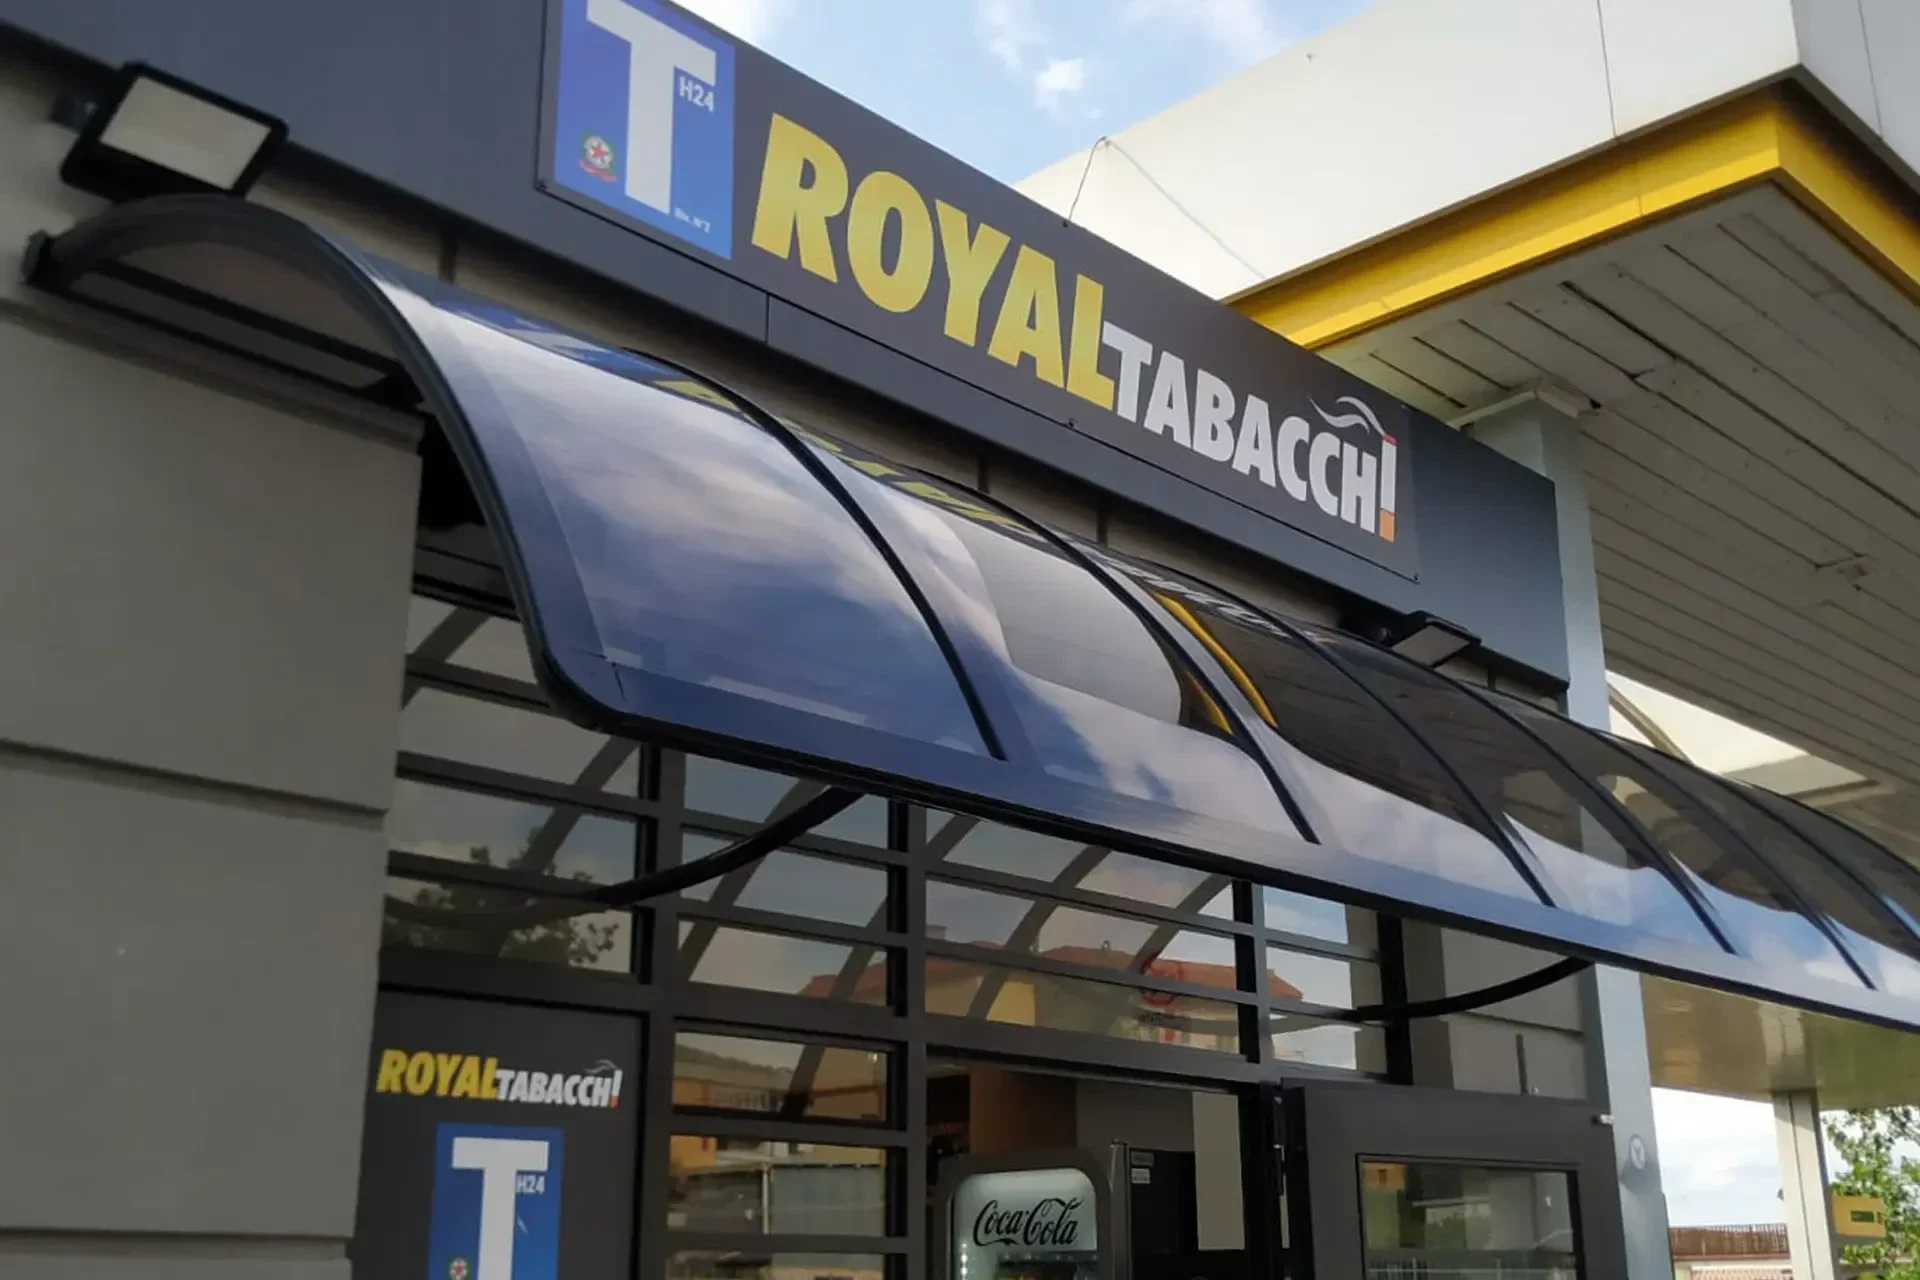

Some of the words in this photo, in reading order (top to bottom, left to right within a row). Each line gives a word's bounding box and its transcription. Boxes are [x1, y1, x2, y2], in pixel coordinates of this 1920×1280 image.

[586, 0, 716, 215] T
[679, 75, 715, 112] H24
[452, 1137, 549, 1280] T
[516, 1174, 545, 1195] H24
